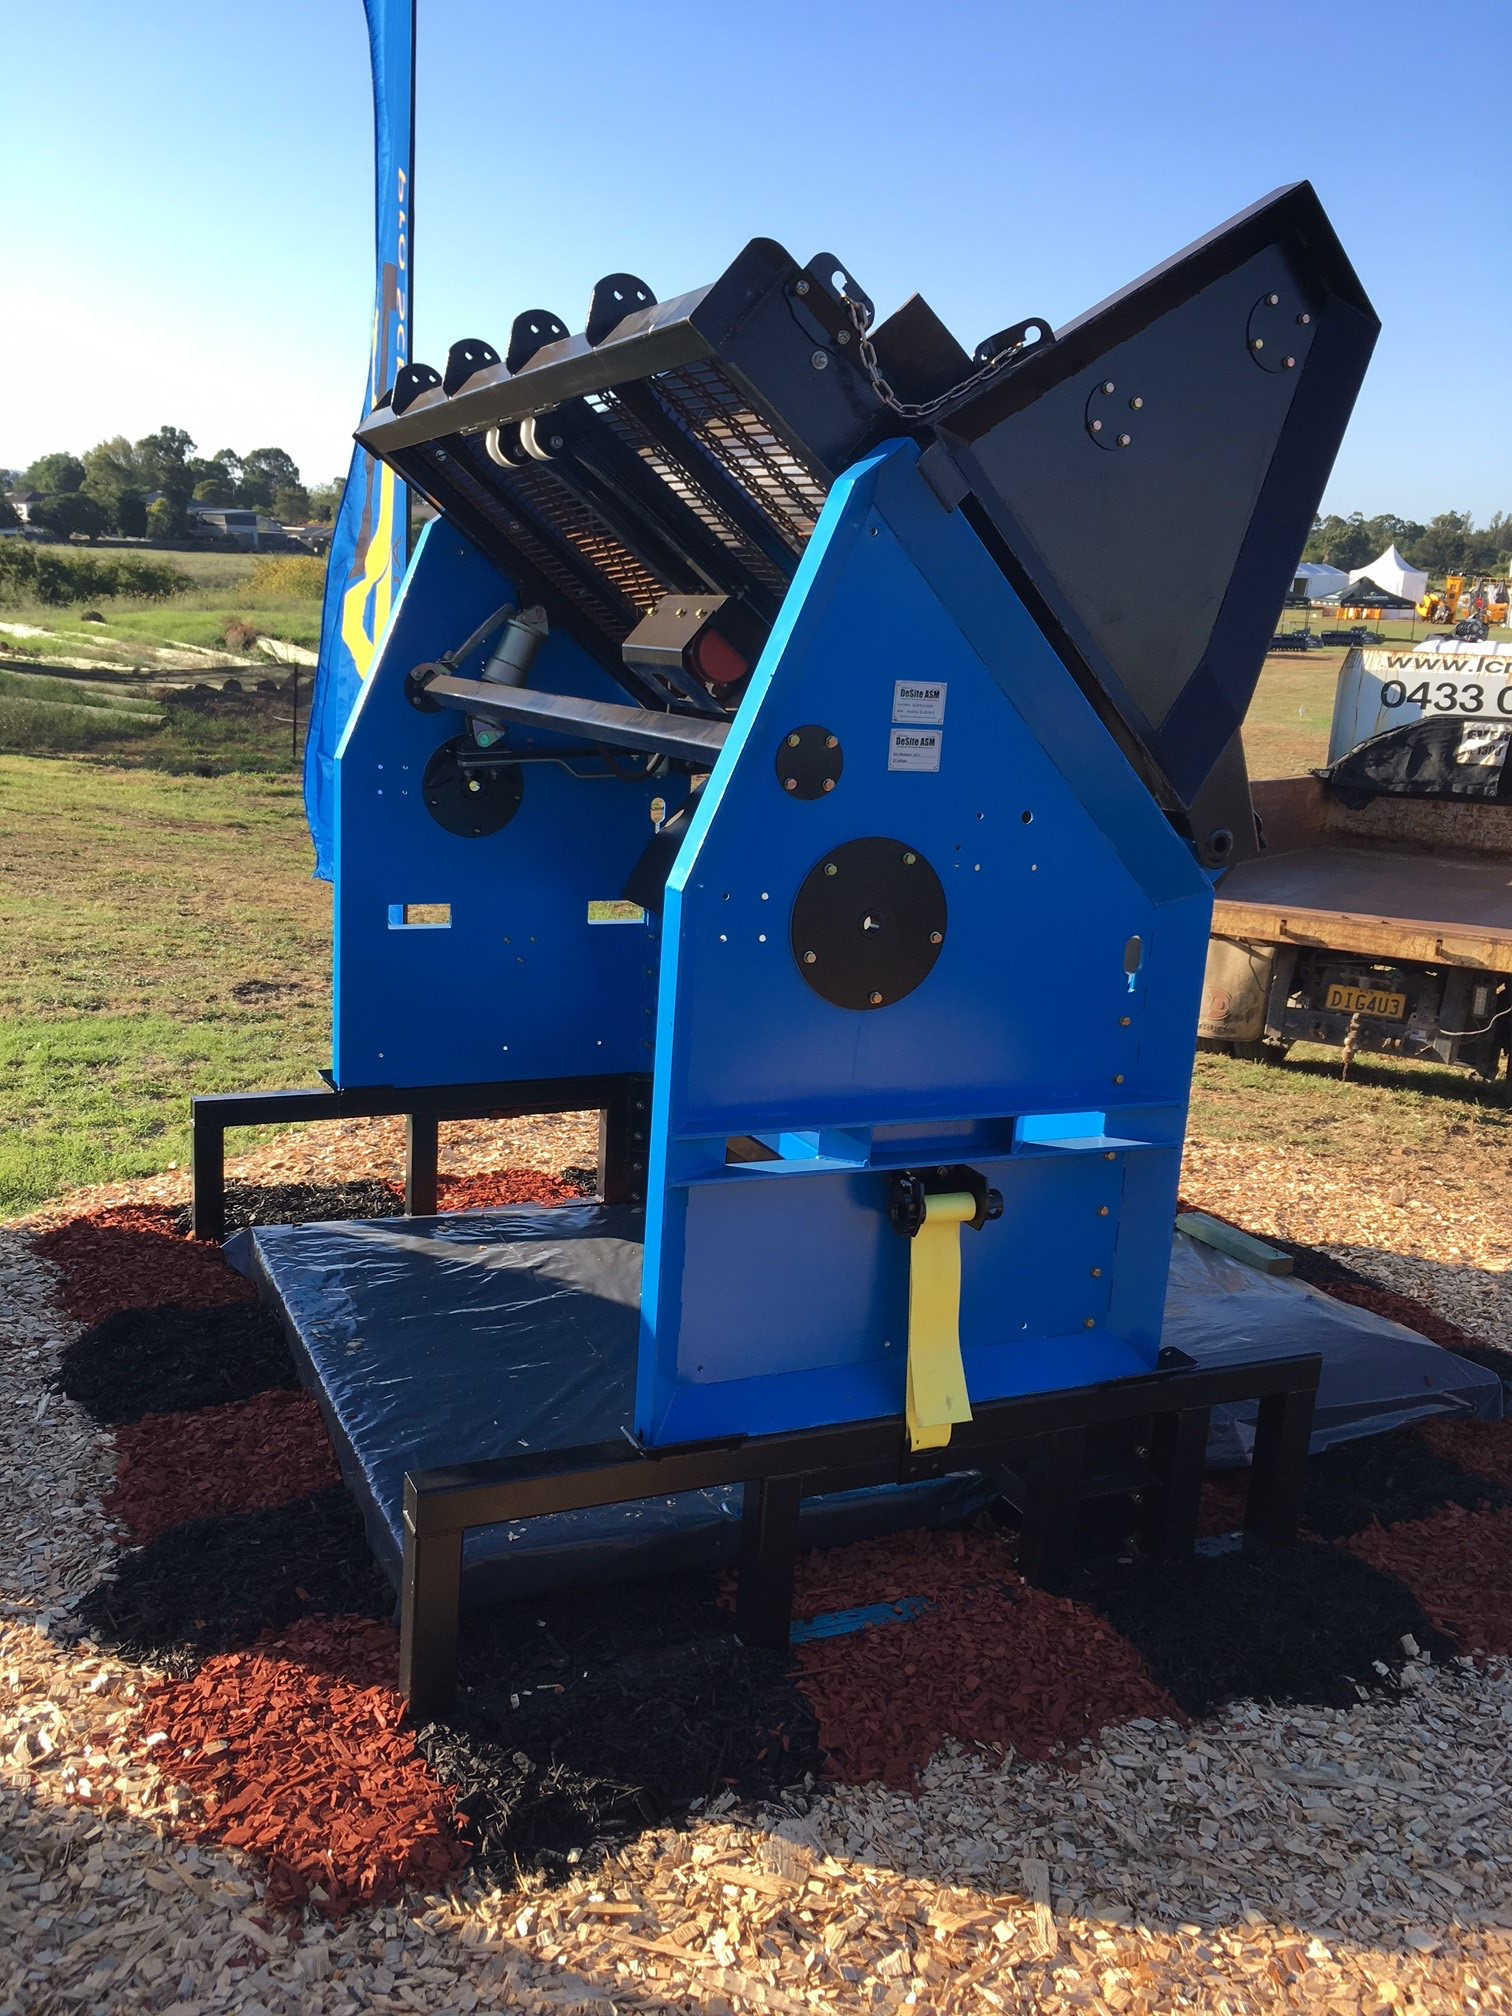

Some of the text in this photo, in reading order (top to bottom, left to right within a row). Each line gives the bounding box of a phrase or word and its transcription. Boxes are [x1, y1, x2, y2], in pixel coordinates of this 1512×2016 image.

[900, 688, 940, 700] DeSite ASM
[1380, 680, 1484, 713] 0433
[896, 736, 935, 747] DeSite ASM
[1330, 991, 1400, 1015] DIG4U3
